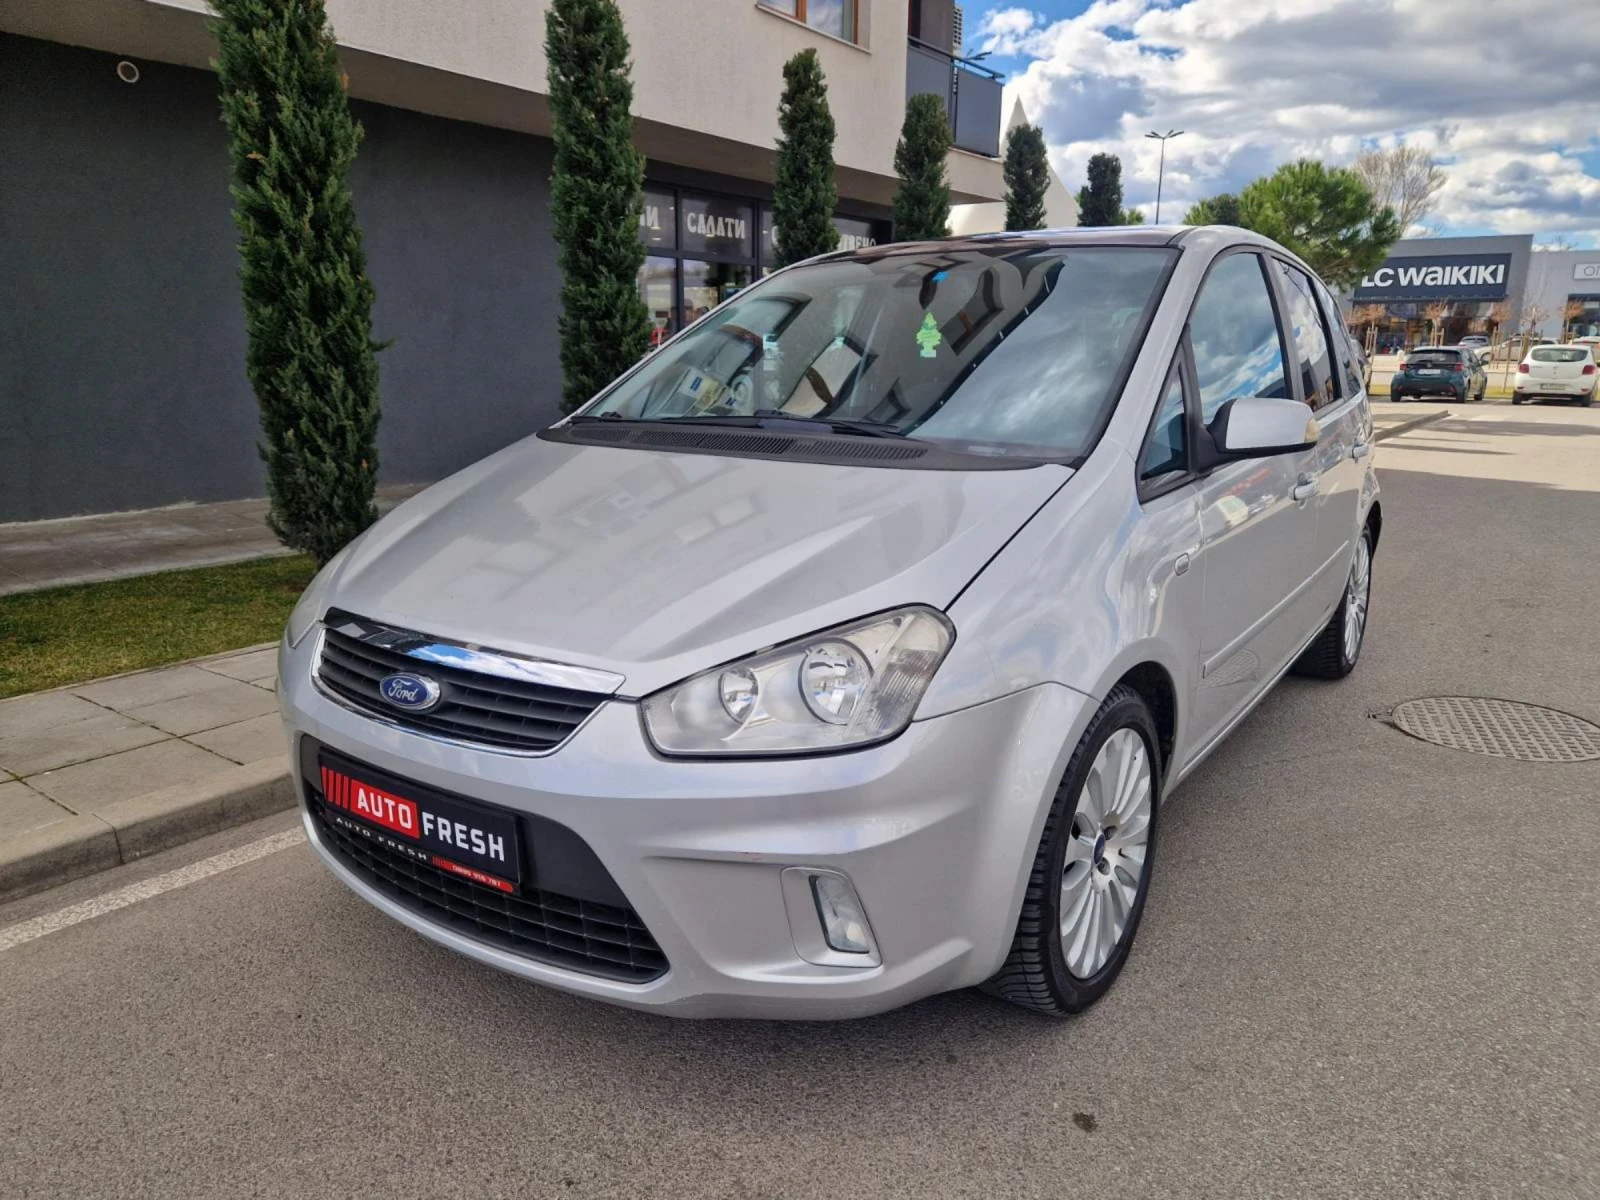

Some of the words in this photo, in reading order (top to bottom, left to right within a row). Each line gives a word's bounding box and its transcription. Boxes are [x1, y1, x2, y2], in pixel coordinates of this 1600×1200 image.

[687, 212, 746, 239] САЛАТИ
[1361, 267, 1394, 287] LC
[388, 678, 419, 702] Ford
[357, 787, 412, 829] AUTO
[421, 811, 505, 862] FRESH
[336, 817, 371, 837] AUTO
[378, 836, 427, 860] FRESH
